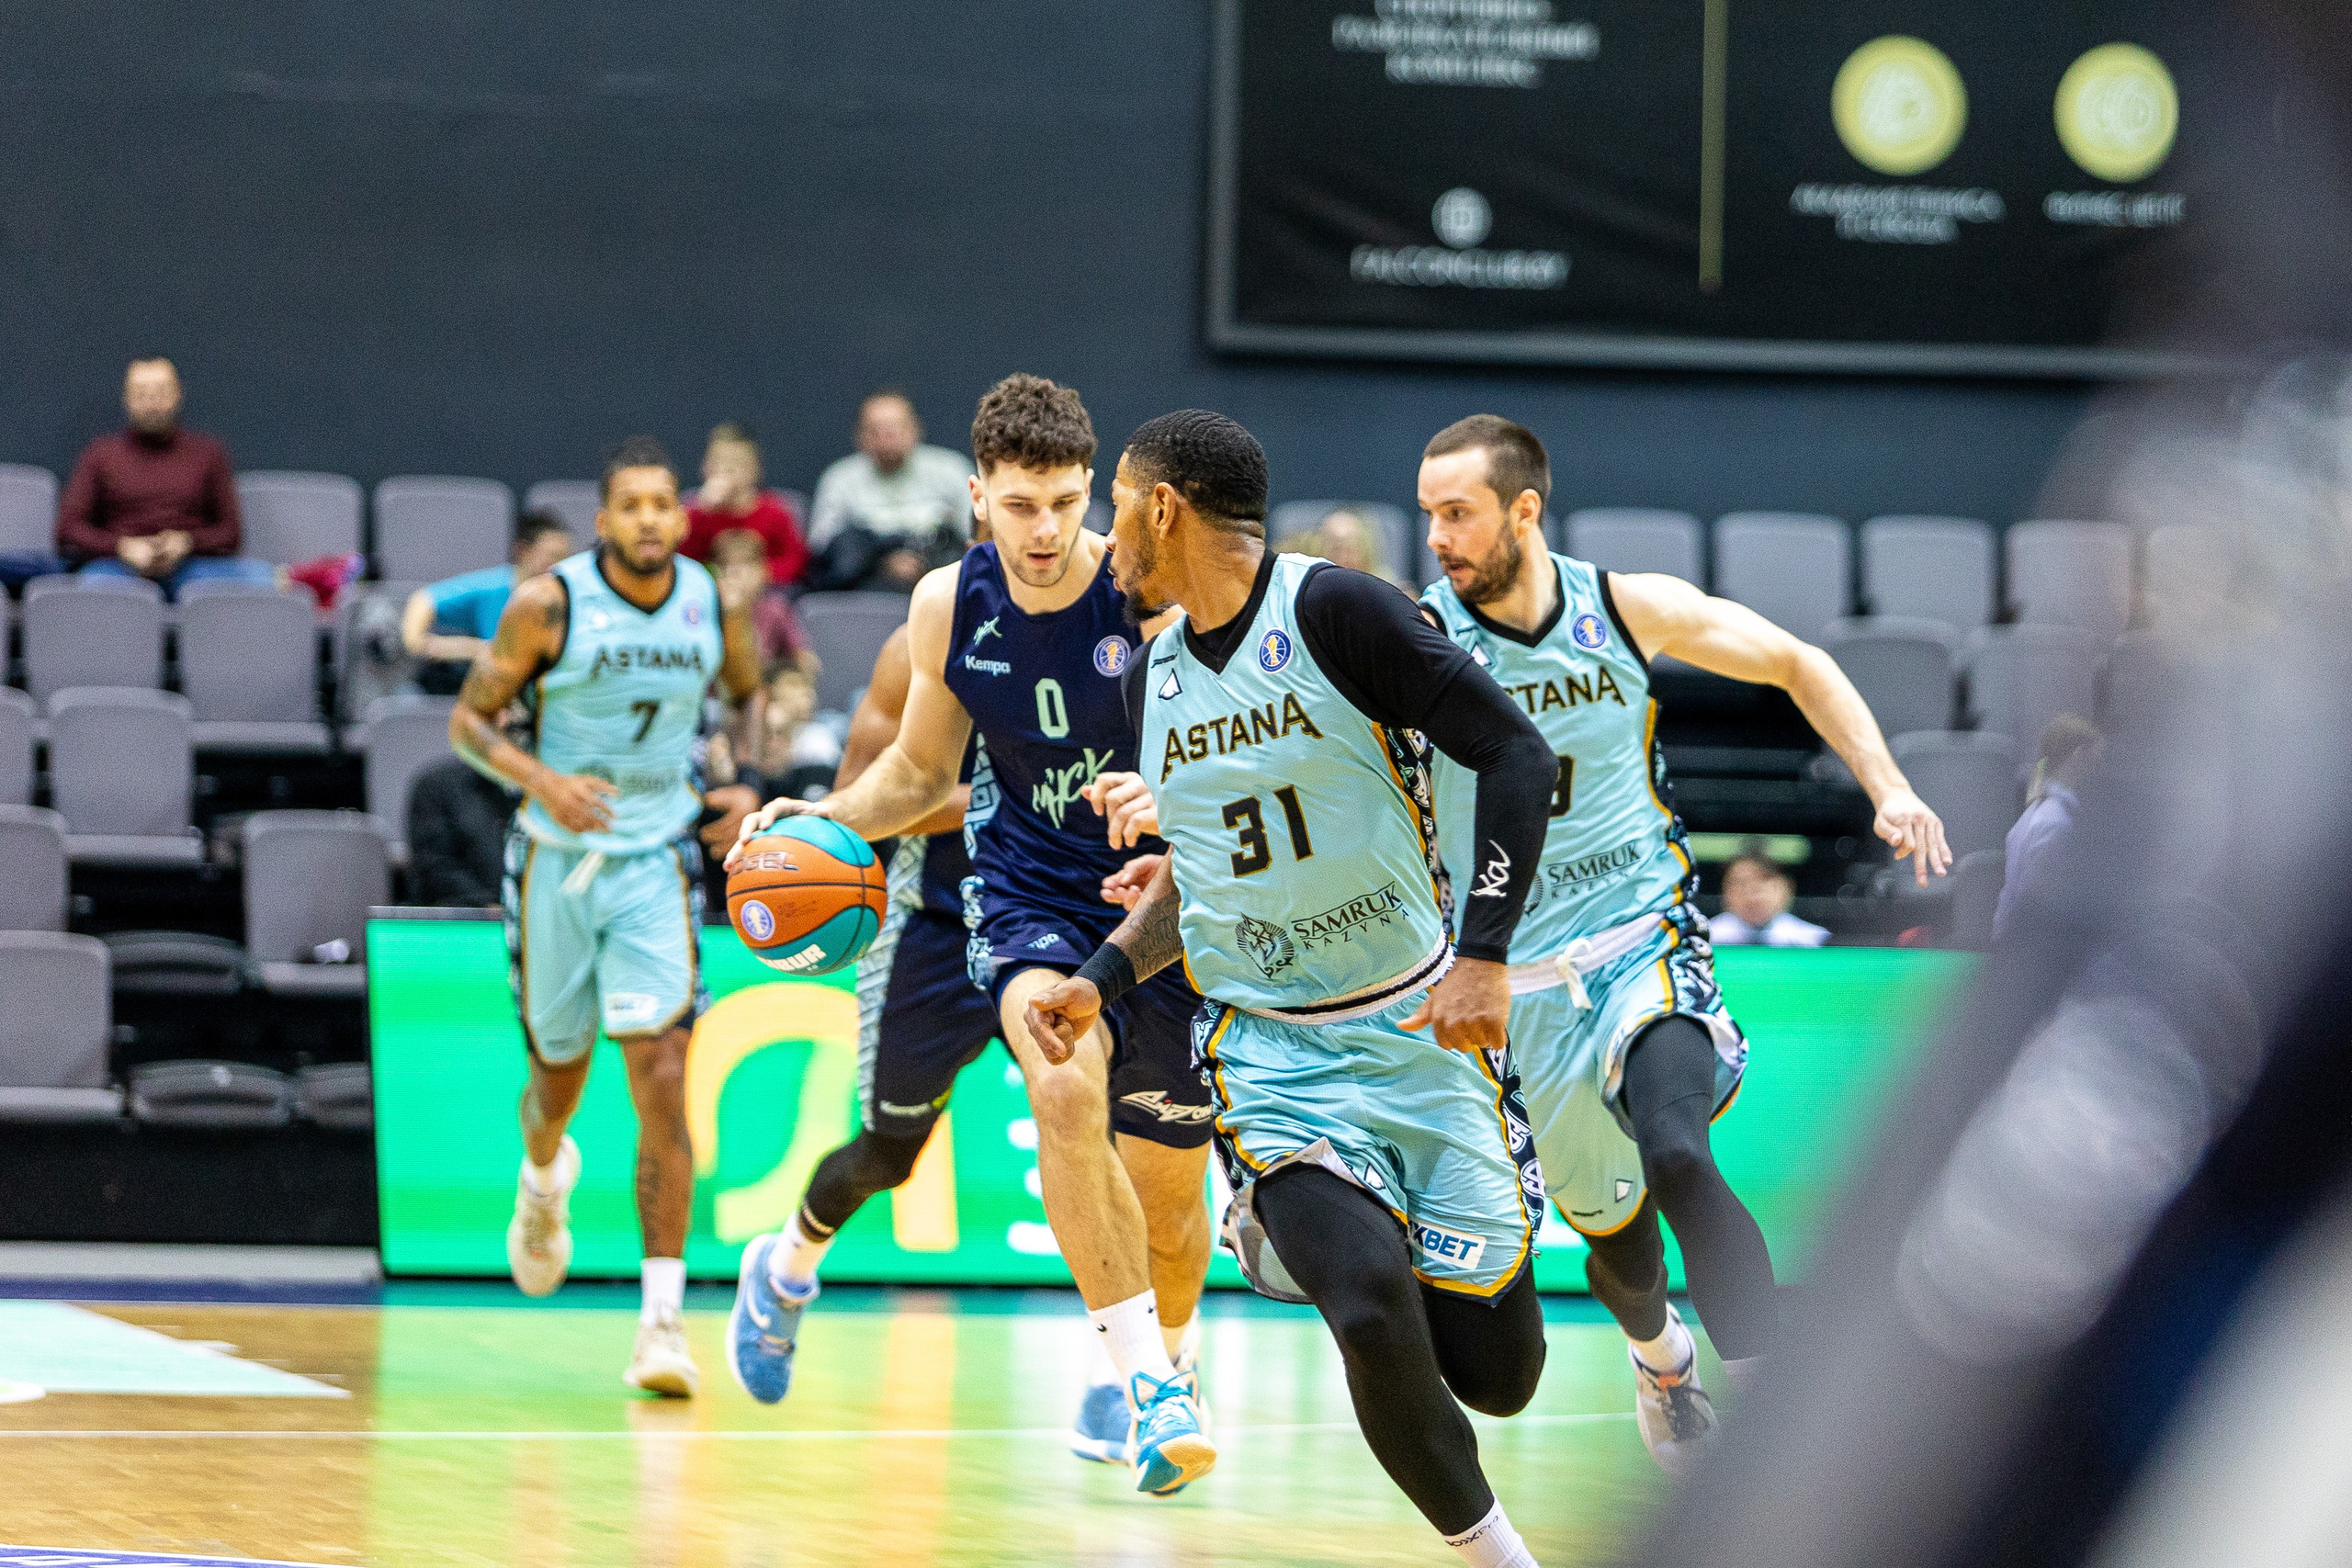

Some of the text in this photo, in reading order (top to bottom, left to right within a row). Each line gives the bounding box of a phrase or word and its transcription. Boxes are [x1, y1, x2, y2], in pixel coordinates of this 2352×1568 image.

[590, 647, 706, 682] ASTANA
[966, 655, 1012, 677] Kempa
[1503, 664, 1627, 715] TANA
[630, 698, 661, 743] 7
[1035, 678, 1070, 739] 0
[1160, 693, 1324, 784] ASTANA
[1222, 784, 1314, 877] 31
[1548, 842, 1641, 886] SAMRUK
[1293, 884, 1402, 938] SAMRUK
